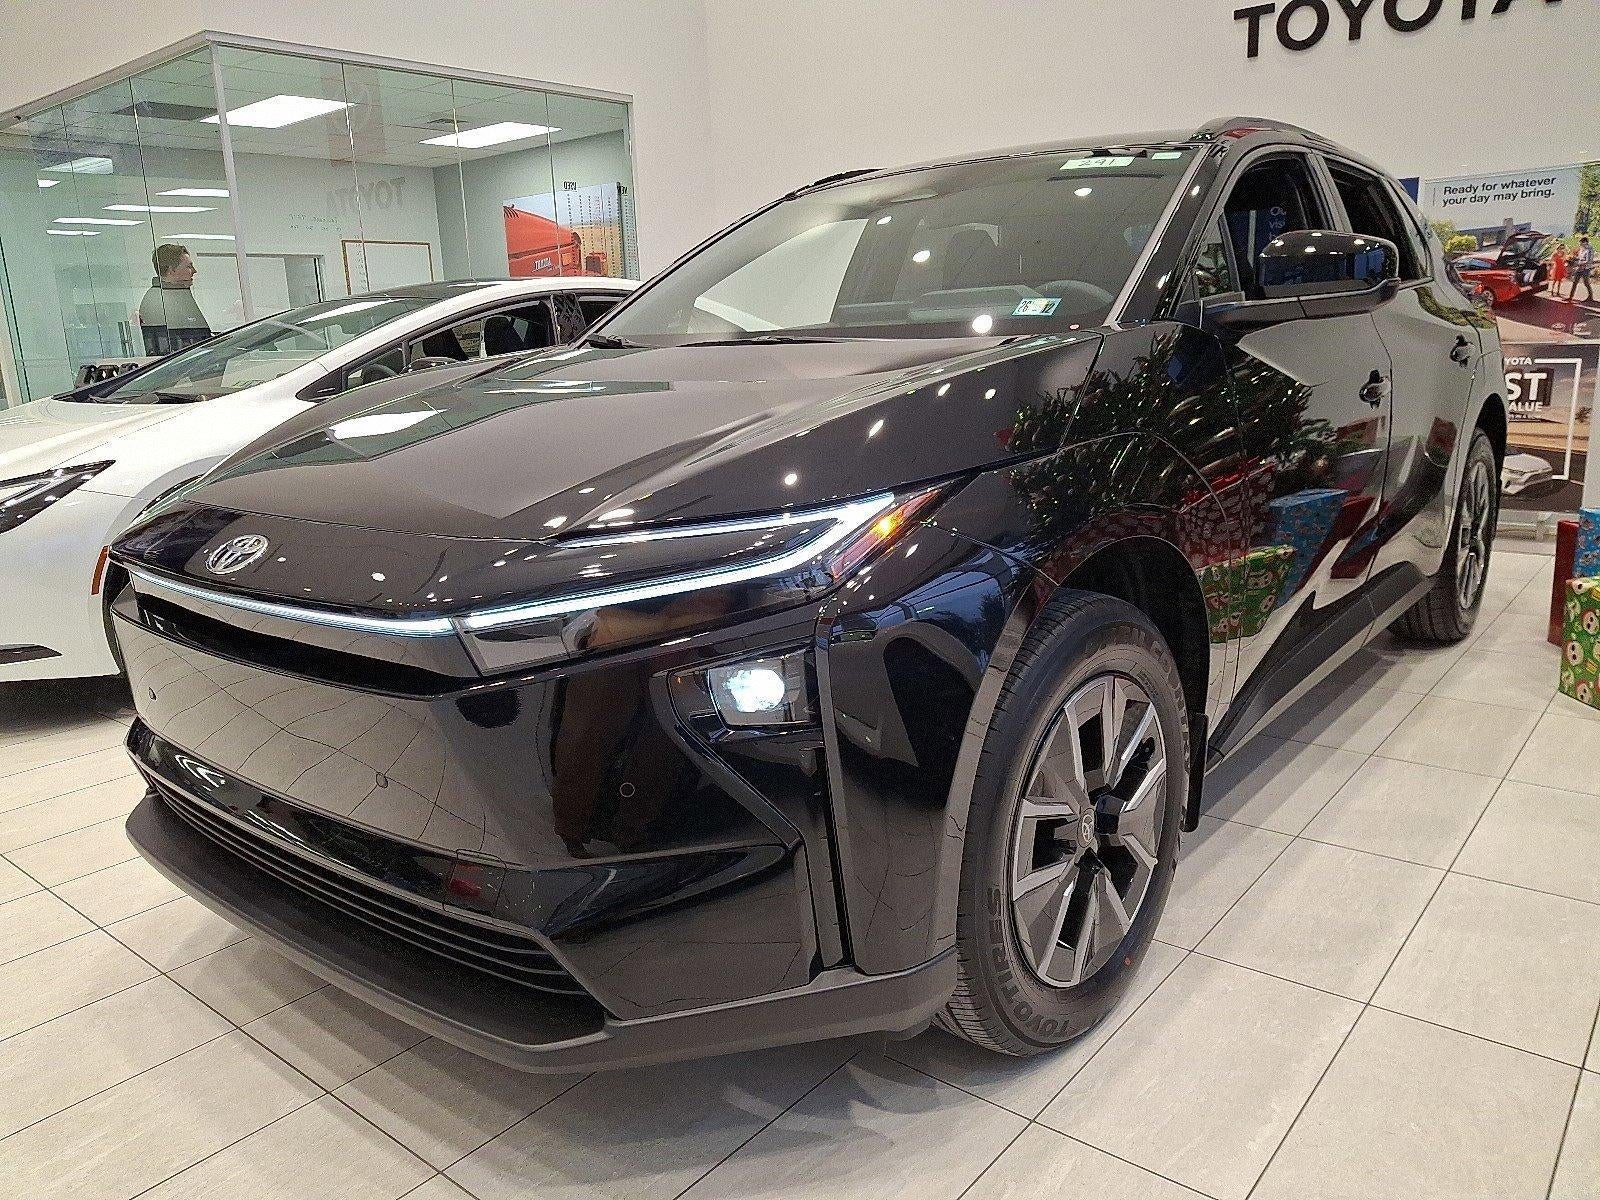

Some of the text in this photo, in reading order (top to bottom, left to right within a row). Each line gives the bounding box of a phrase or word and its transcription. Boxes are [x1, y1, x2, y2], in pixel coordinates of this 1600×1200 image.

[1233, 0, 1560, 58] TOYO
[1443, 177, 1556, 195] Ready for whatever
[1442, 188, 1555, 208] your day may bring.
[1503, 357, 1532, 366] YOTA
[1505, 372, 1547, 401] ST
[1508, 401, 1544, 412] ALUE
[1013, 1000, 1078, 1039] TOYO
